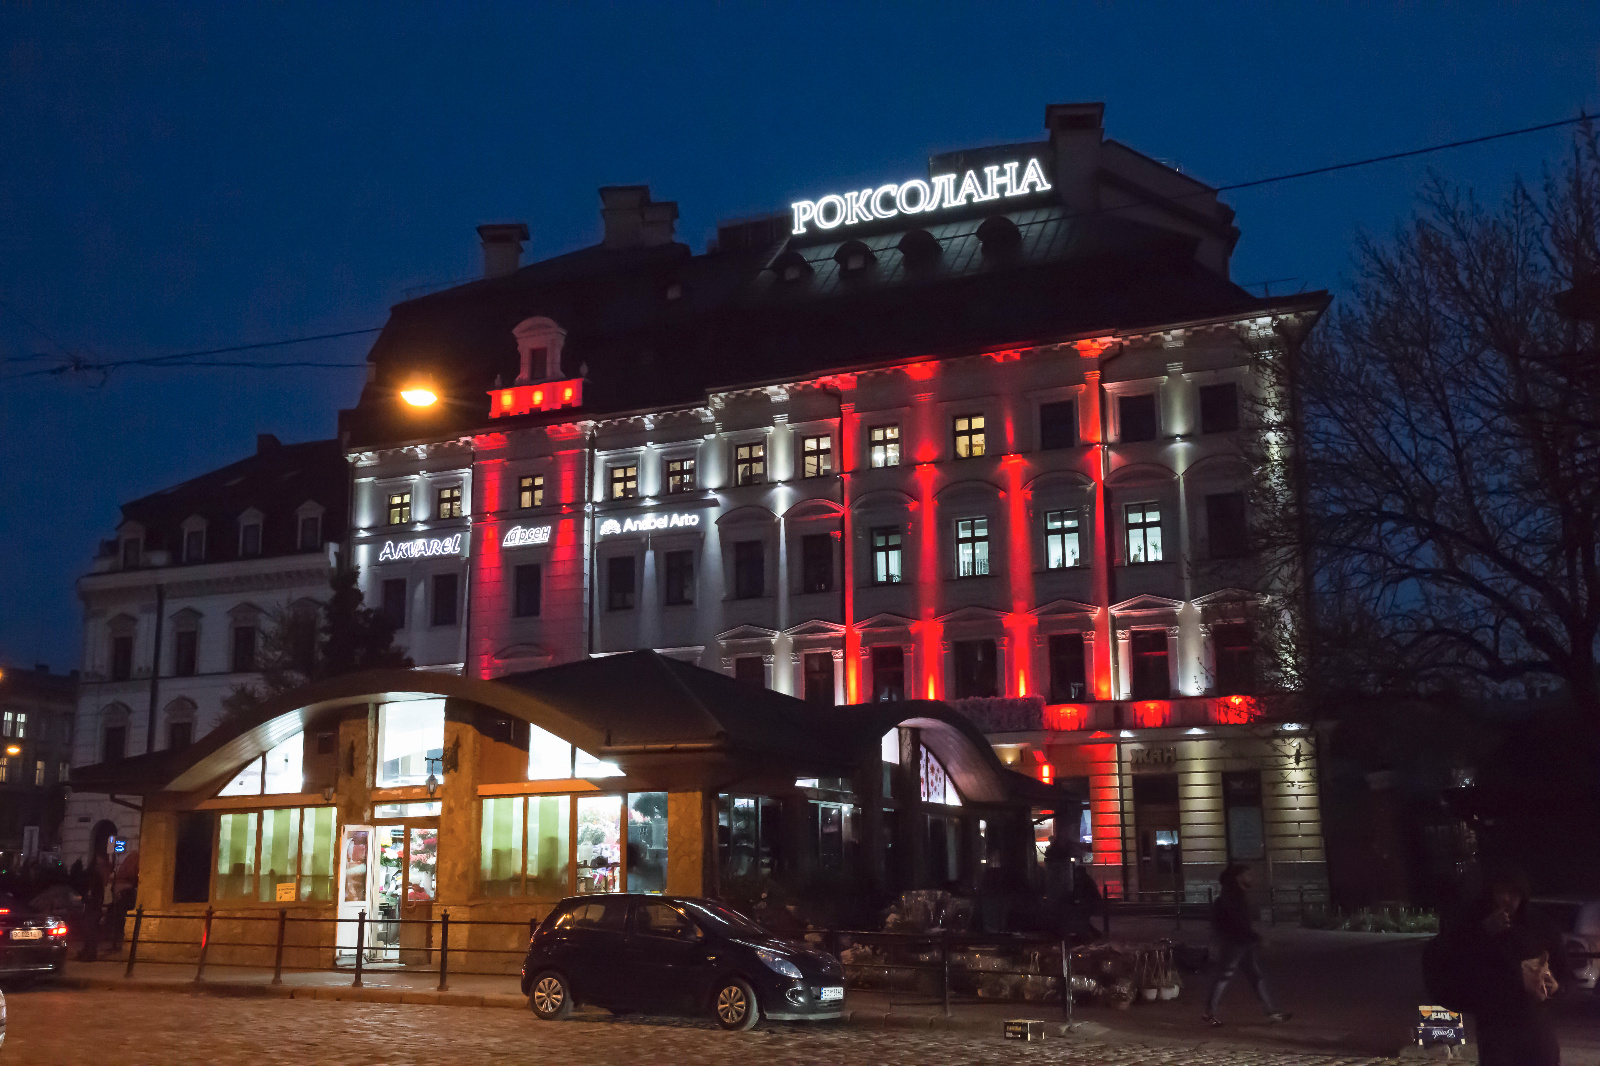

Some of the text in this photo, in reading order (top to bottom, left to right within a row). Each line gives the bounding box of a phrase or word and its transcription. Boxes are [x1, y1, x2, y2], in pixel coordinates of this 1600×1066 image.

[792, 158, 1051, 234] РОКСОЛАНА
[623, 513, 699, 532] Anabel Arto
